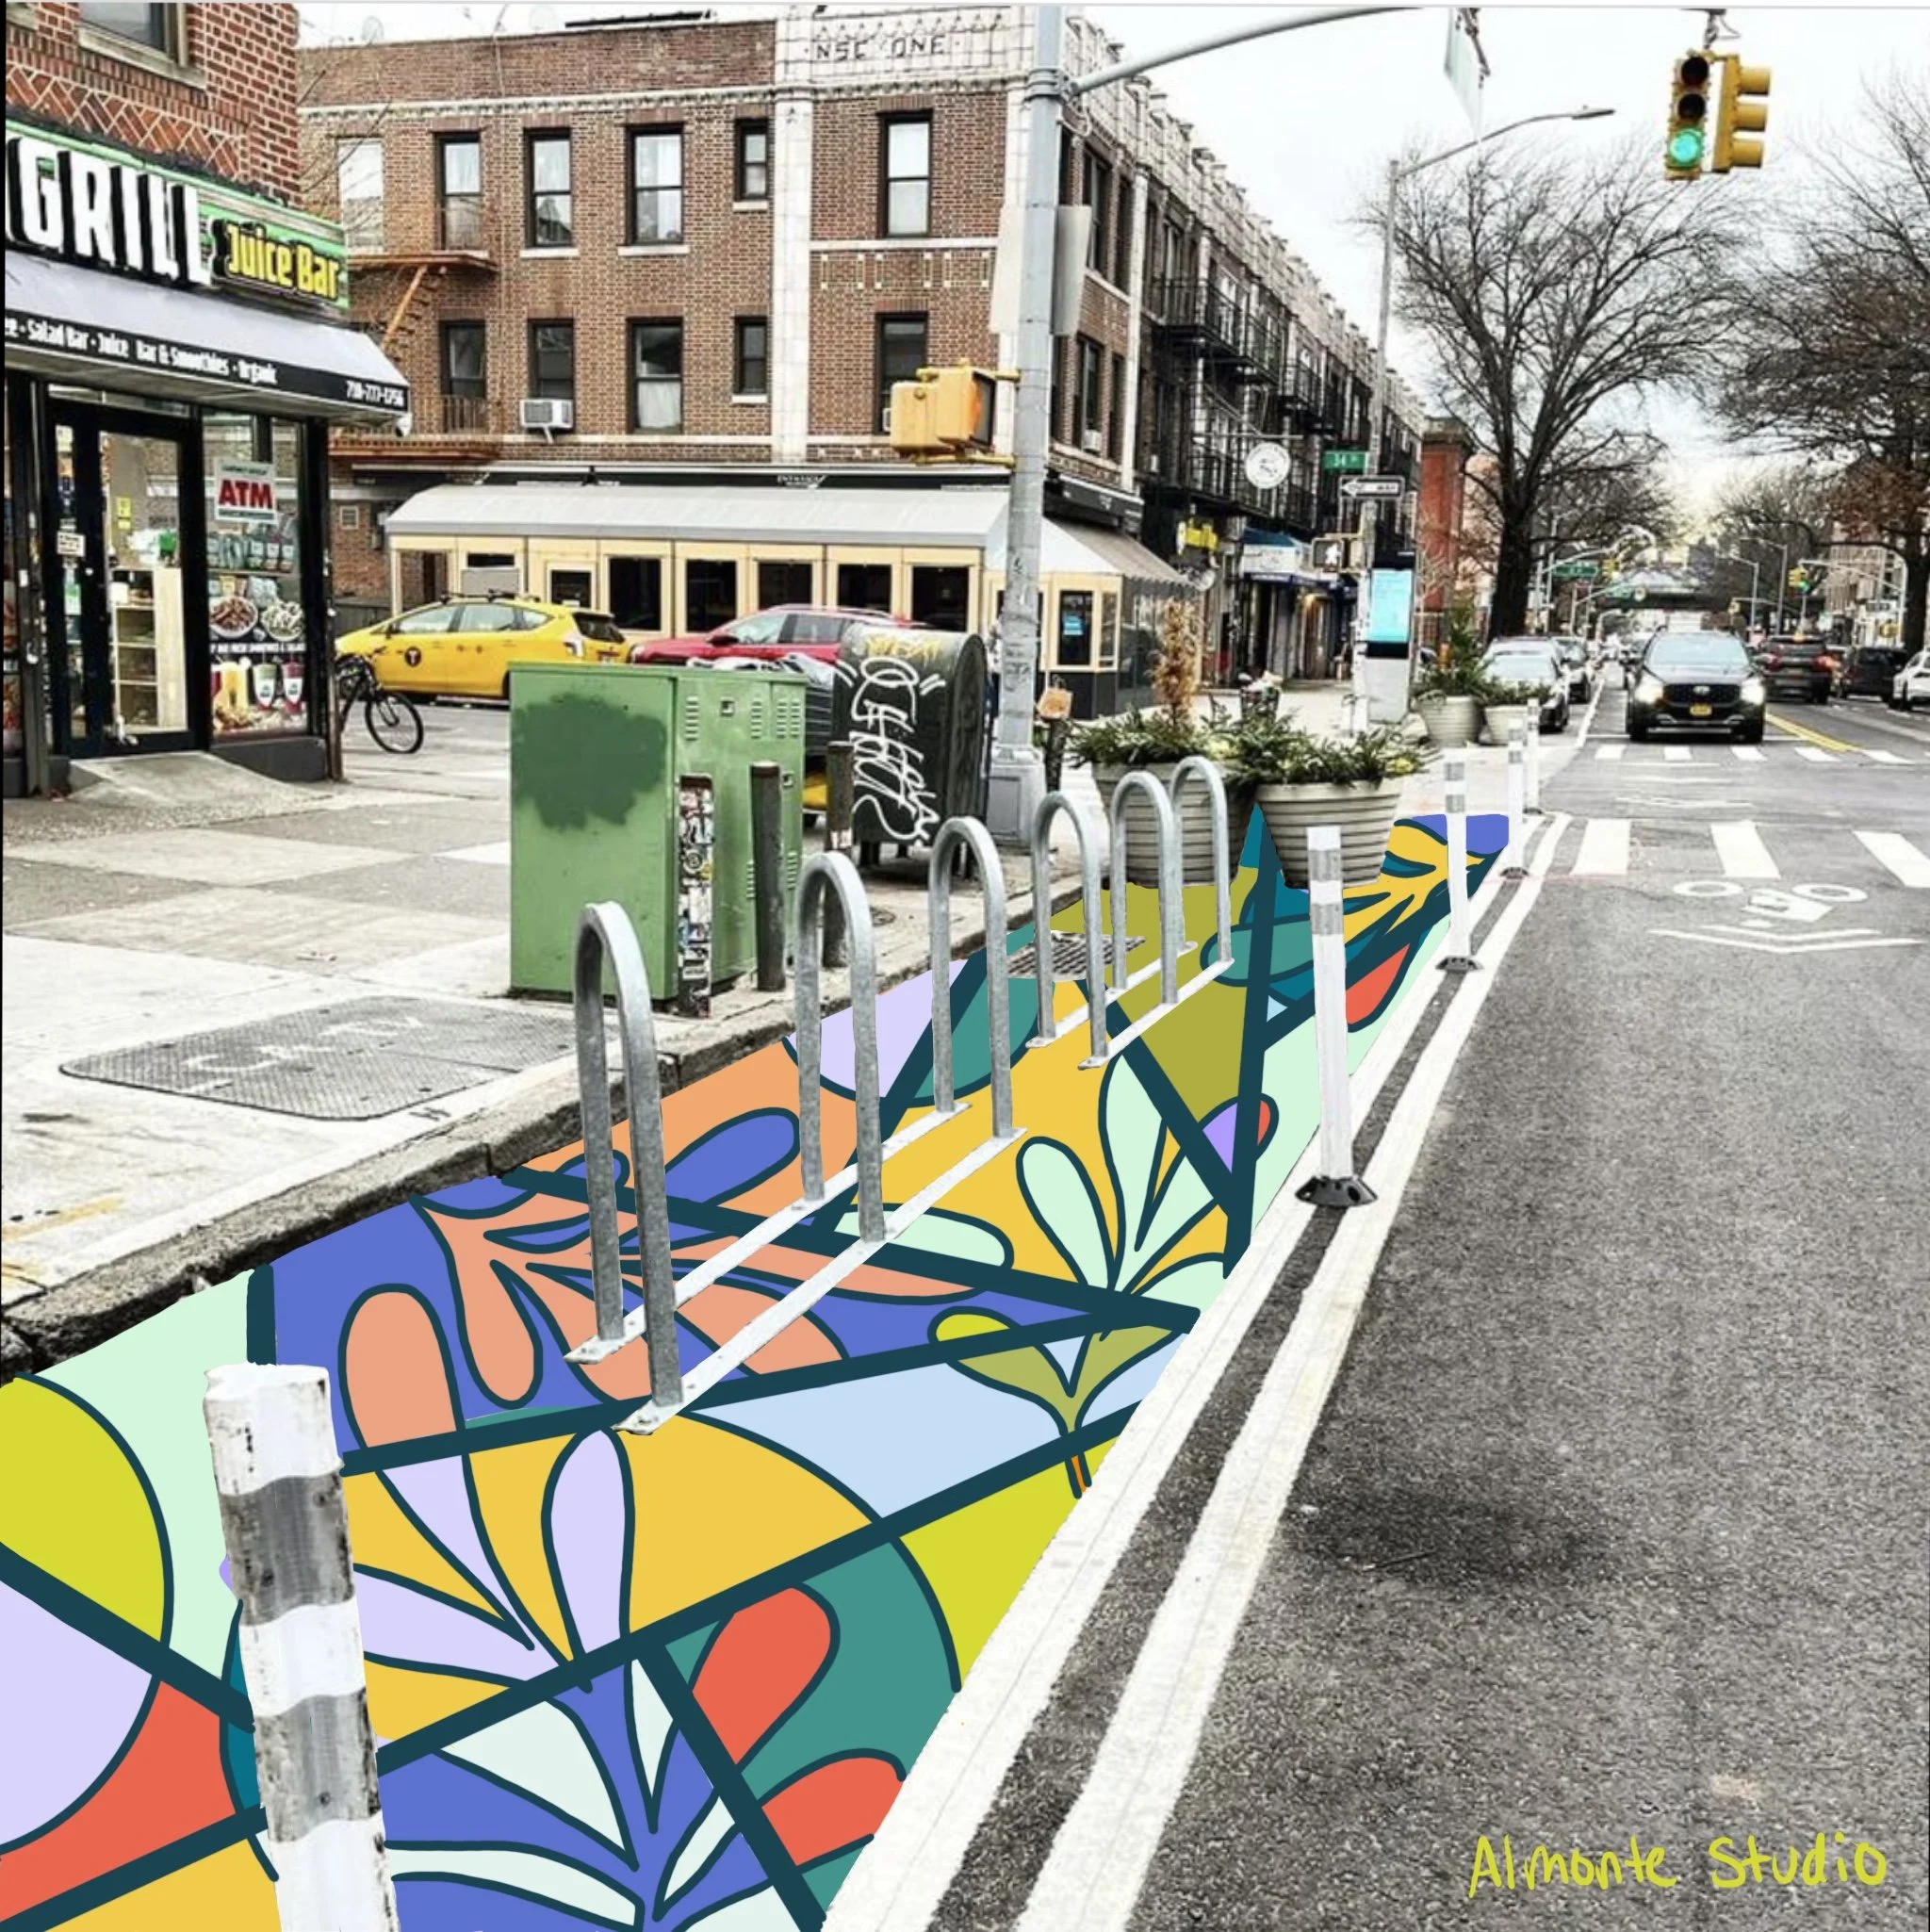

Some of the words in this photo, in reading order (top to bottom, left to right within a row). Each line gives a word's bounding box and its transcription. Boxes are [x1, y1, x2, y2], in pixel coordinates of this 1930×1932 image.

[891, 35, 945, 58] ONE
[8, 136, 211, 285] GRILL
[229, 224, 293, 287] Juice
[296, 242, 338, 299] Bar
[27, 319, 65, 347] Salad
[66, 326, 90, 351] Bar
[219, 479, 273, 509] ATM
